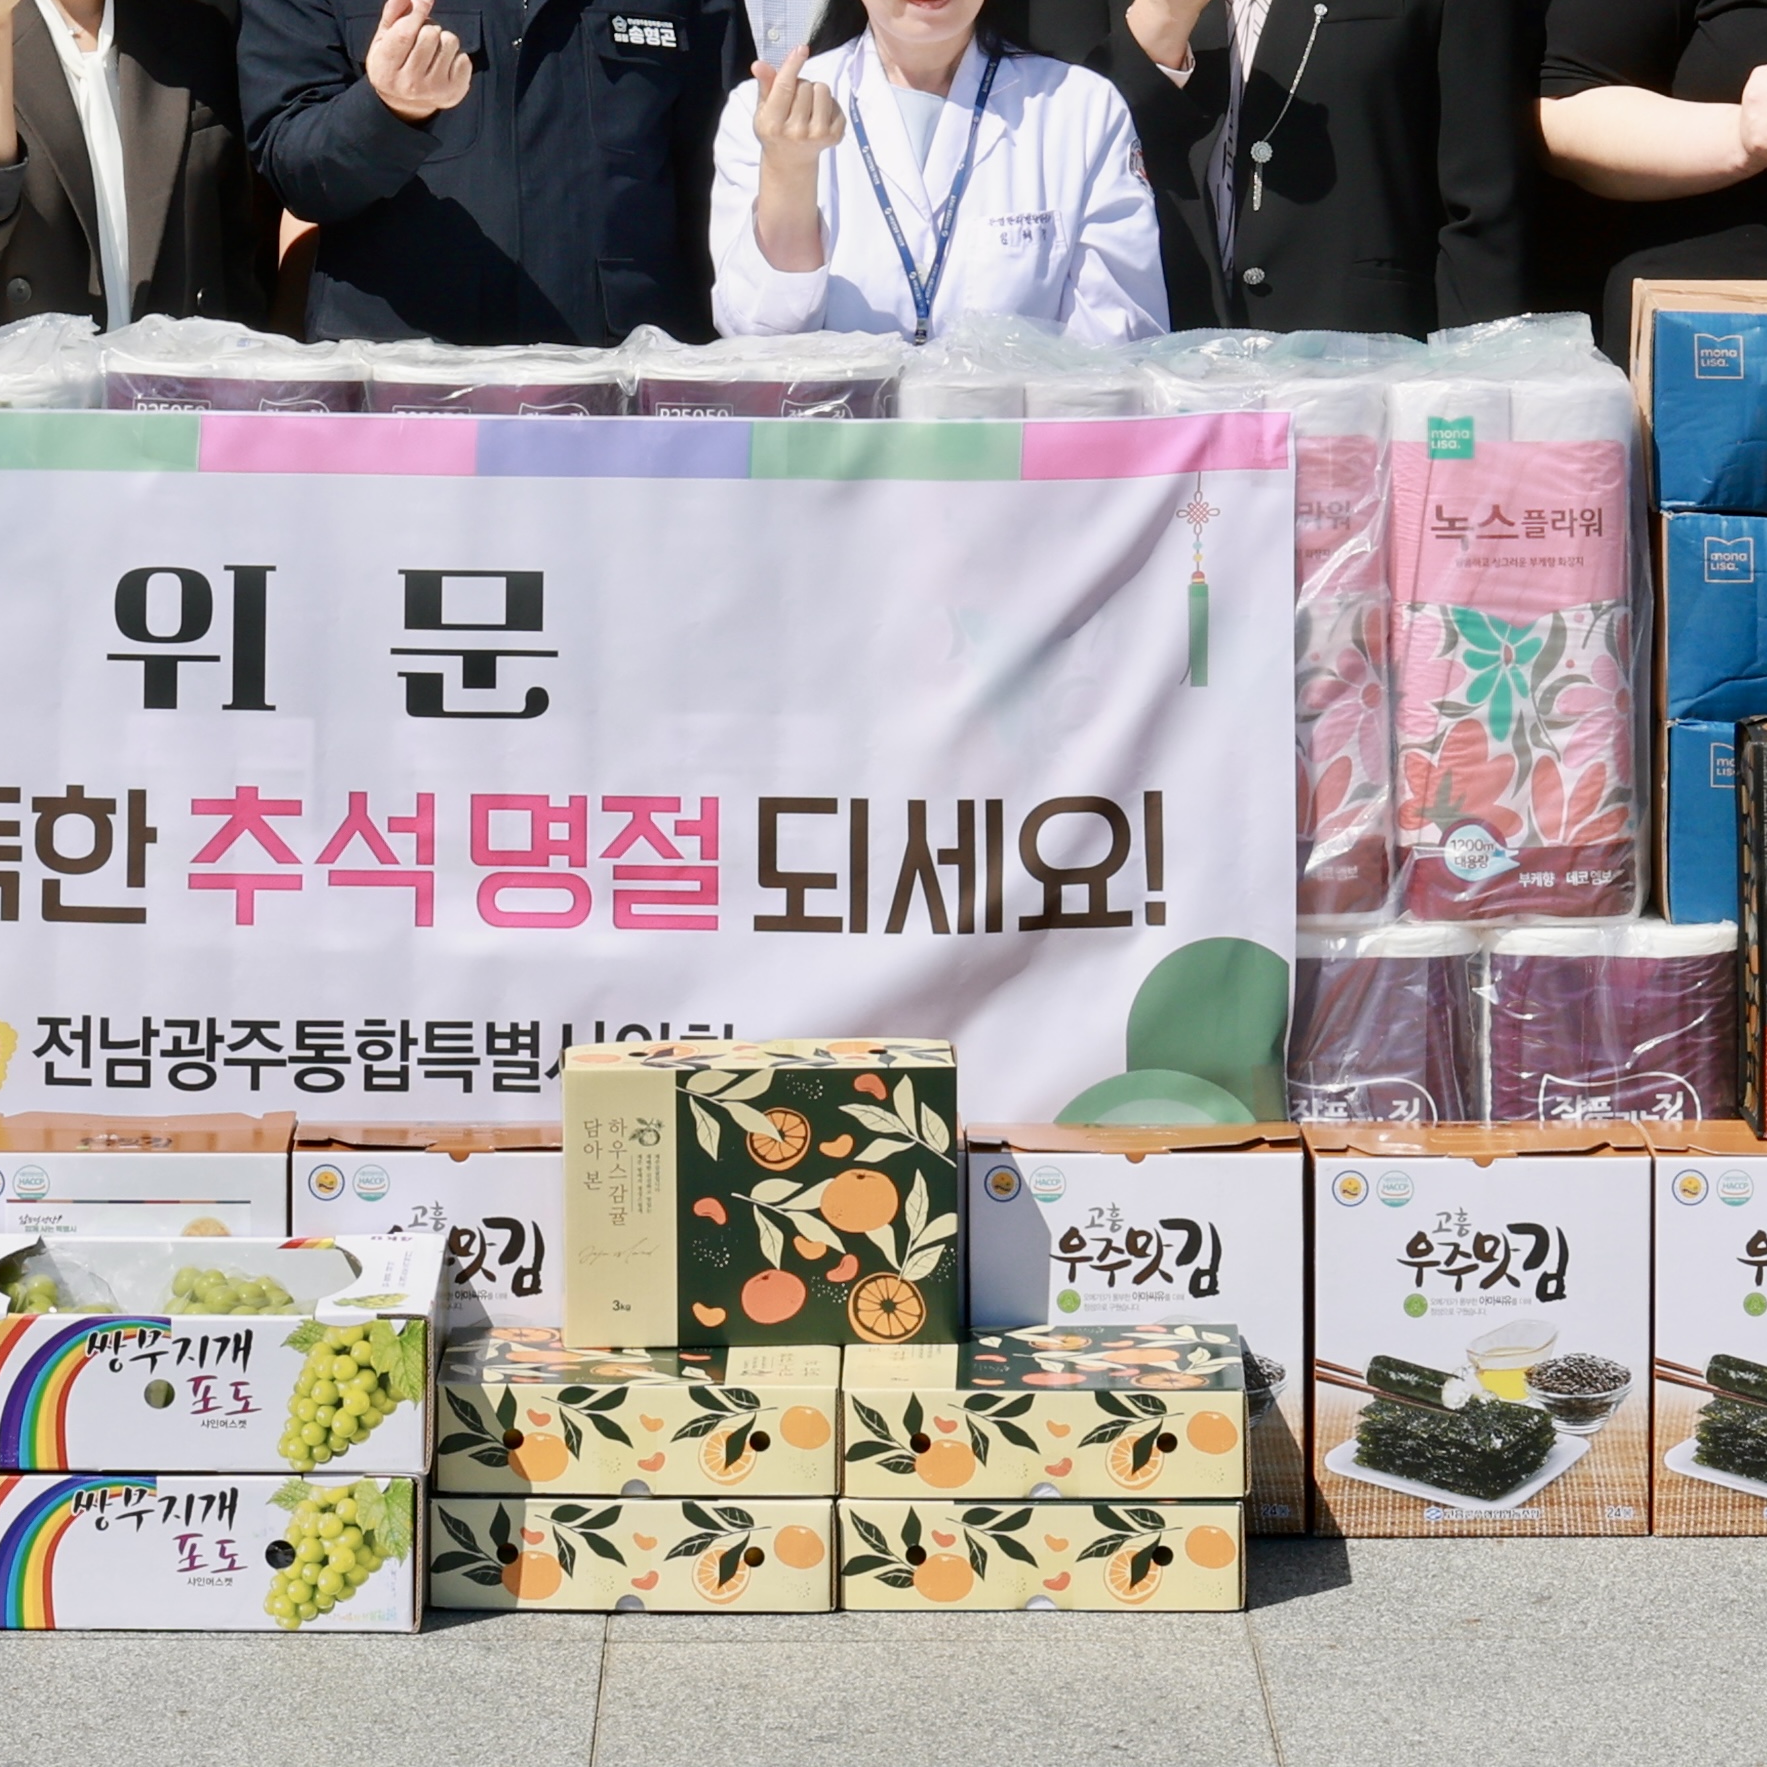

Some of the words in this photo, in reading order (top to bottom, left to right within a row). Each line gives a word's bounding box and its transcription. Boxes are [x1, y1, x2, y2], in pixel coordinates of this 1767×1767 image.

[187, 784, 436, 929] 추석
[470, 792, 721, 931] 명절
[753, 790, 1168, 935] 되세요!
[1454, 855, 1489, 869] 대용량
[1518, 872, 1556, 887] 부케향
[1566, 871, 1589, 885] 데코
[32, 1015, 734, 1093] 전남광주통합특별
[608, 1117, 628, 1226] 하우스감귤
[1049, 1218, 1221, 1296] 우주맛김
[1397, 1223, 1569, 1301] 우주맛김
[612, 1299, 631, 1312] 3kg
[86, 1328, 254, 1374] 쌍무지개
[186, 1374, 262, 1415] 포도
[200, 1418, 248, 1430] 샤인머스켓
